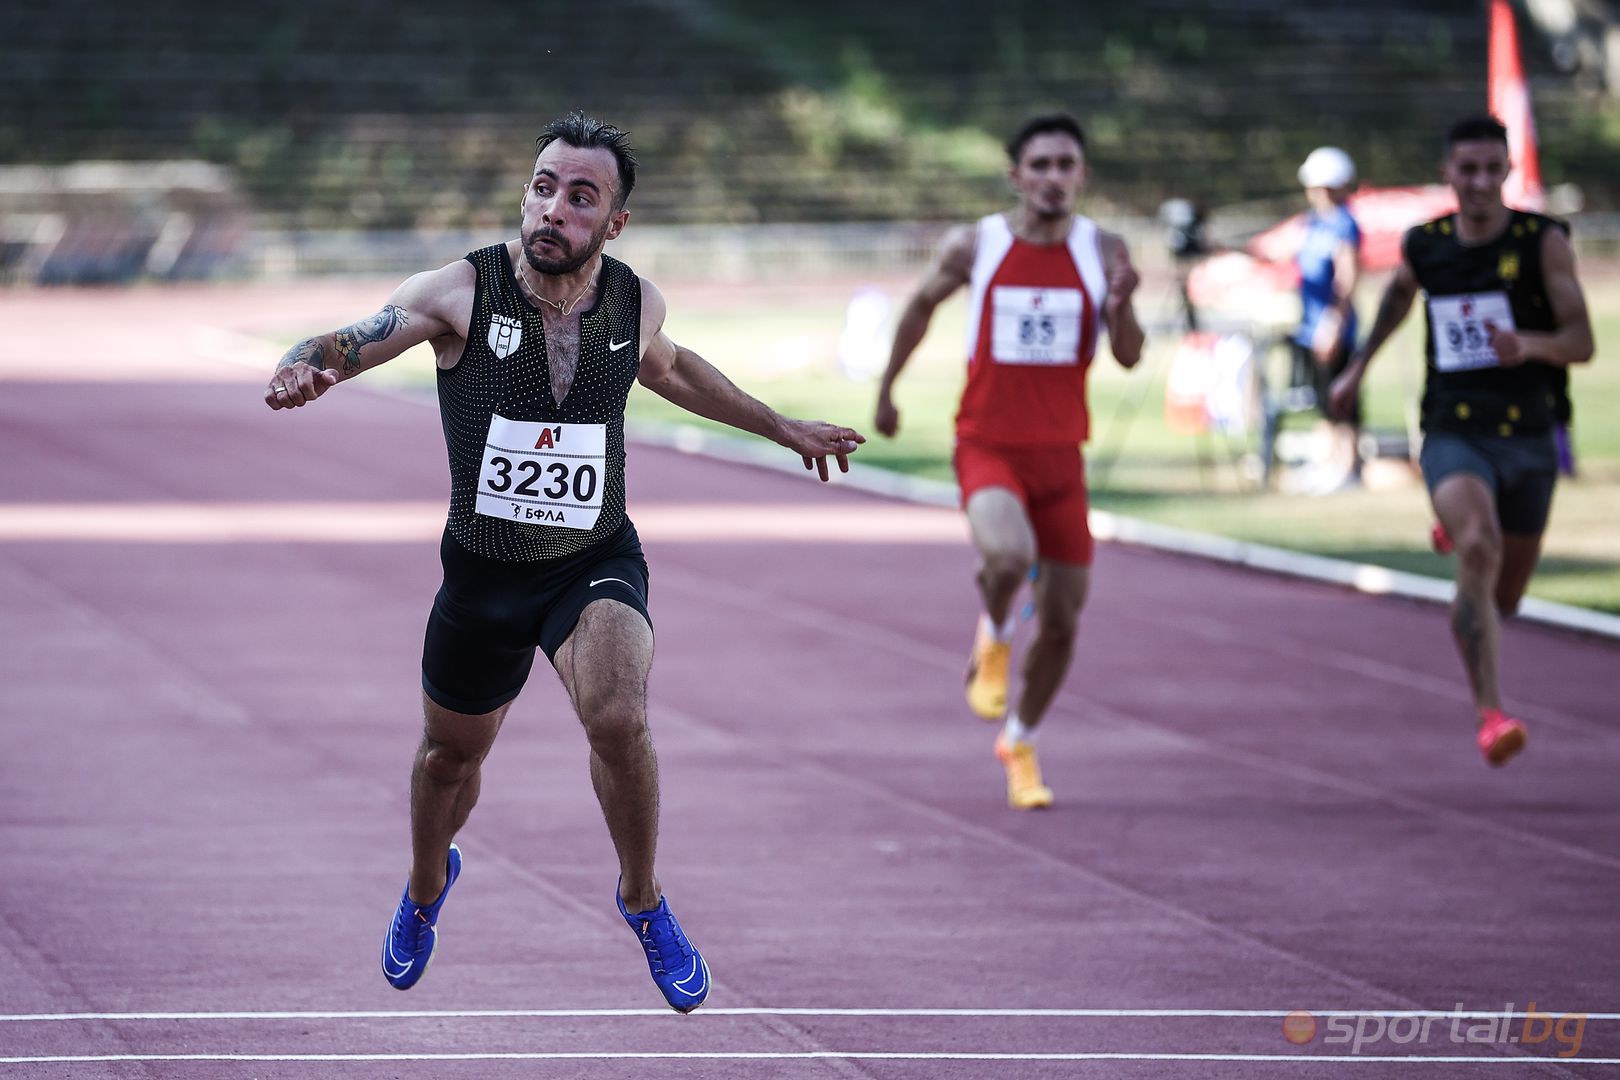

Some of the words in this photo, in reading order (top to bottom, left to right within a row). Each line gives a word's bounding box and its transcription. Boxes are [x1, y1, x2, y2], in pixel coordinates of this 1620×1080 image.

[491, 313, 522, 328] ENKA
[534, 426, 562, 449] A1
[487, 456, 597, 502] 3230
[525, 508, 566, 523] БФЛА
